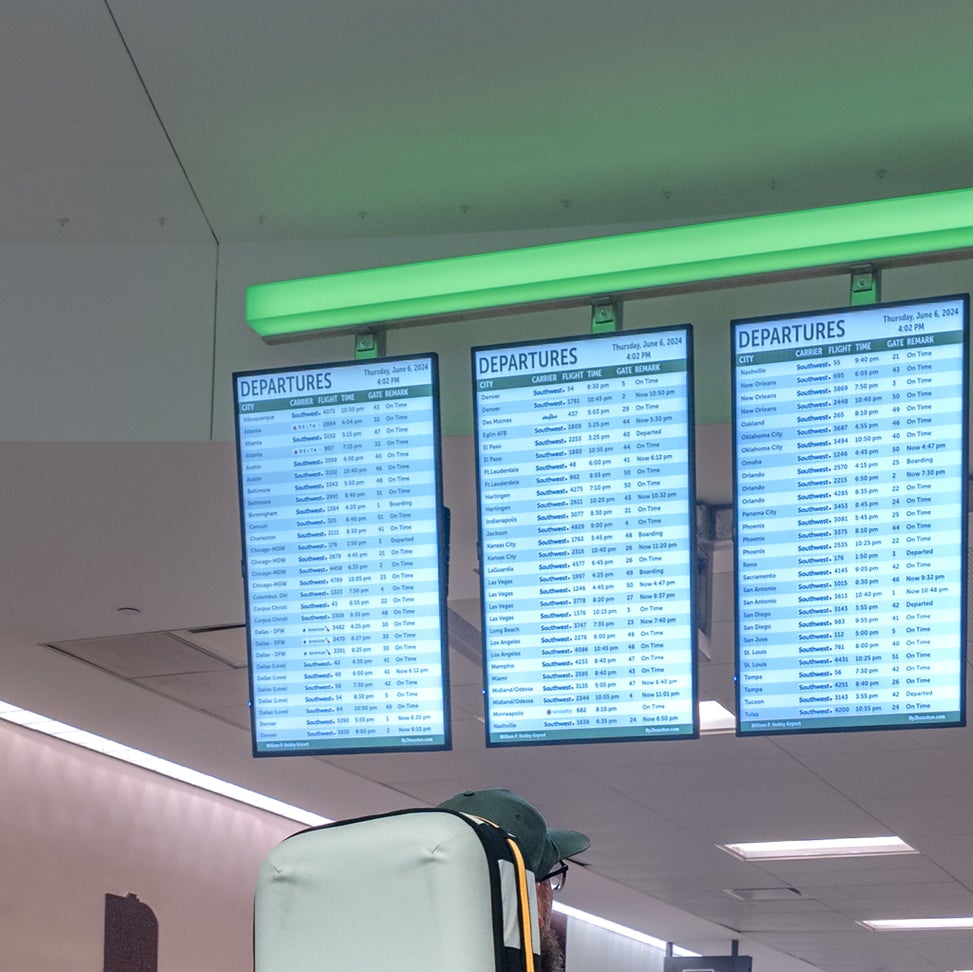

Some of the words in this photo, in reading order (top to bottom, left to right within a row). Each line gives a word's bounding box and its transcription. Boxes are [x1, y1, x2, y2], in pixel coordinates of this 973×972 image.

[883, 313, 914, 323] Thursday,
[916, 311, 932, 320] June
[942, 308, 959, 316] 2024
[739, 320, 845, 348] DEPARTURES
[898, 324, 912, 332] 4:02
[913, 323, 924, 331] PM
[612, 342, 642, 352] Thursday,
[643, 340, 658, 348] June
[667, 337, 682, 345] 2024
[738, 355, 754, 363] CITY
[795, 348, 822, 357] CARRIER
[828, 345, 851, 354] FLIGHT
[855, 342, 871, 351] TIME
[887, 338, 904, 347] GATE
[907, 336, 934, 345] REMARK
[479, 348, 578, 373] DEPARTURES
[626, 352, 639, 360] 4:02
[641, 351, 651, 359] PM
[392, 365, 406, 373] June
[414, 363, 429, 371] 2024
[532, 374, 557, 383] CARRIER
[562, 371, 584, 380] FLIGHT
[587, 369, 602, 377] TIME
[617, 366, 632, 375] GATE
[635, 364, 660, 372] REMARK
[241, 373, 332, 397] DEPARTURES
[390, 376, 400, 384] PM
[241, 403, 254, 411] CITY
[290, 397, 313, 406] CARRIER
[318, 395, 338, 403] FLIGHT
[342, 393, 355, 401] TIME
[368, 390, 383, 399] GATE
[385, 388, 408, 396] REMARK
